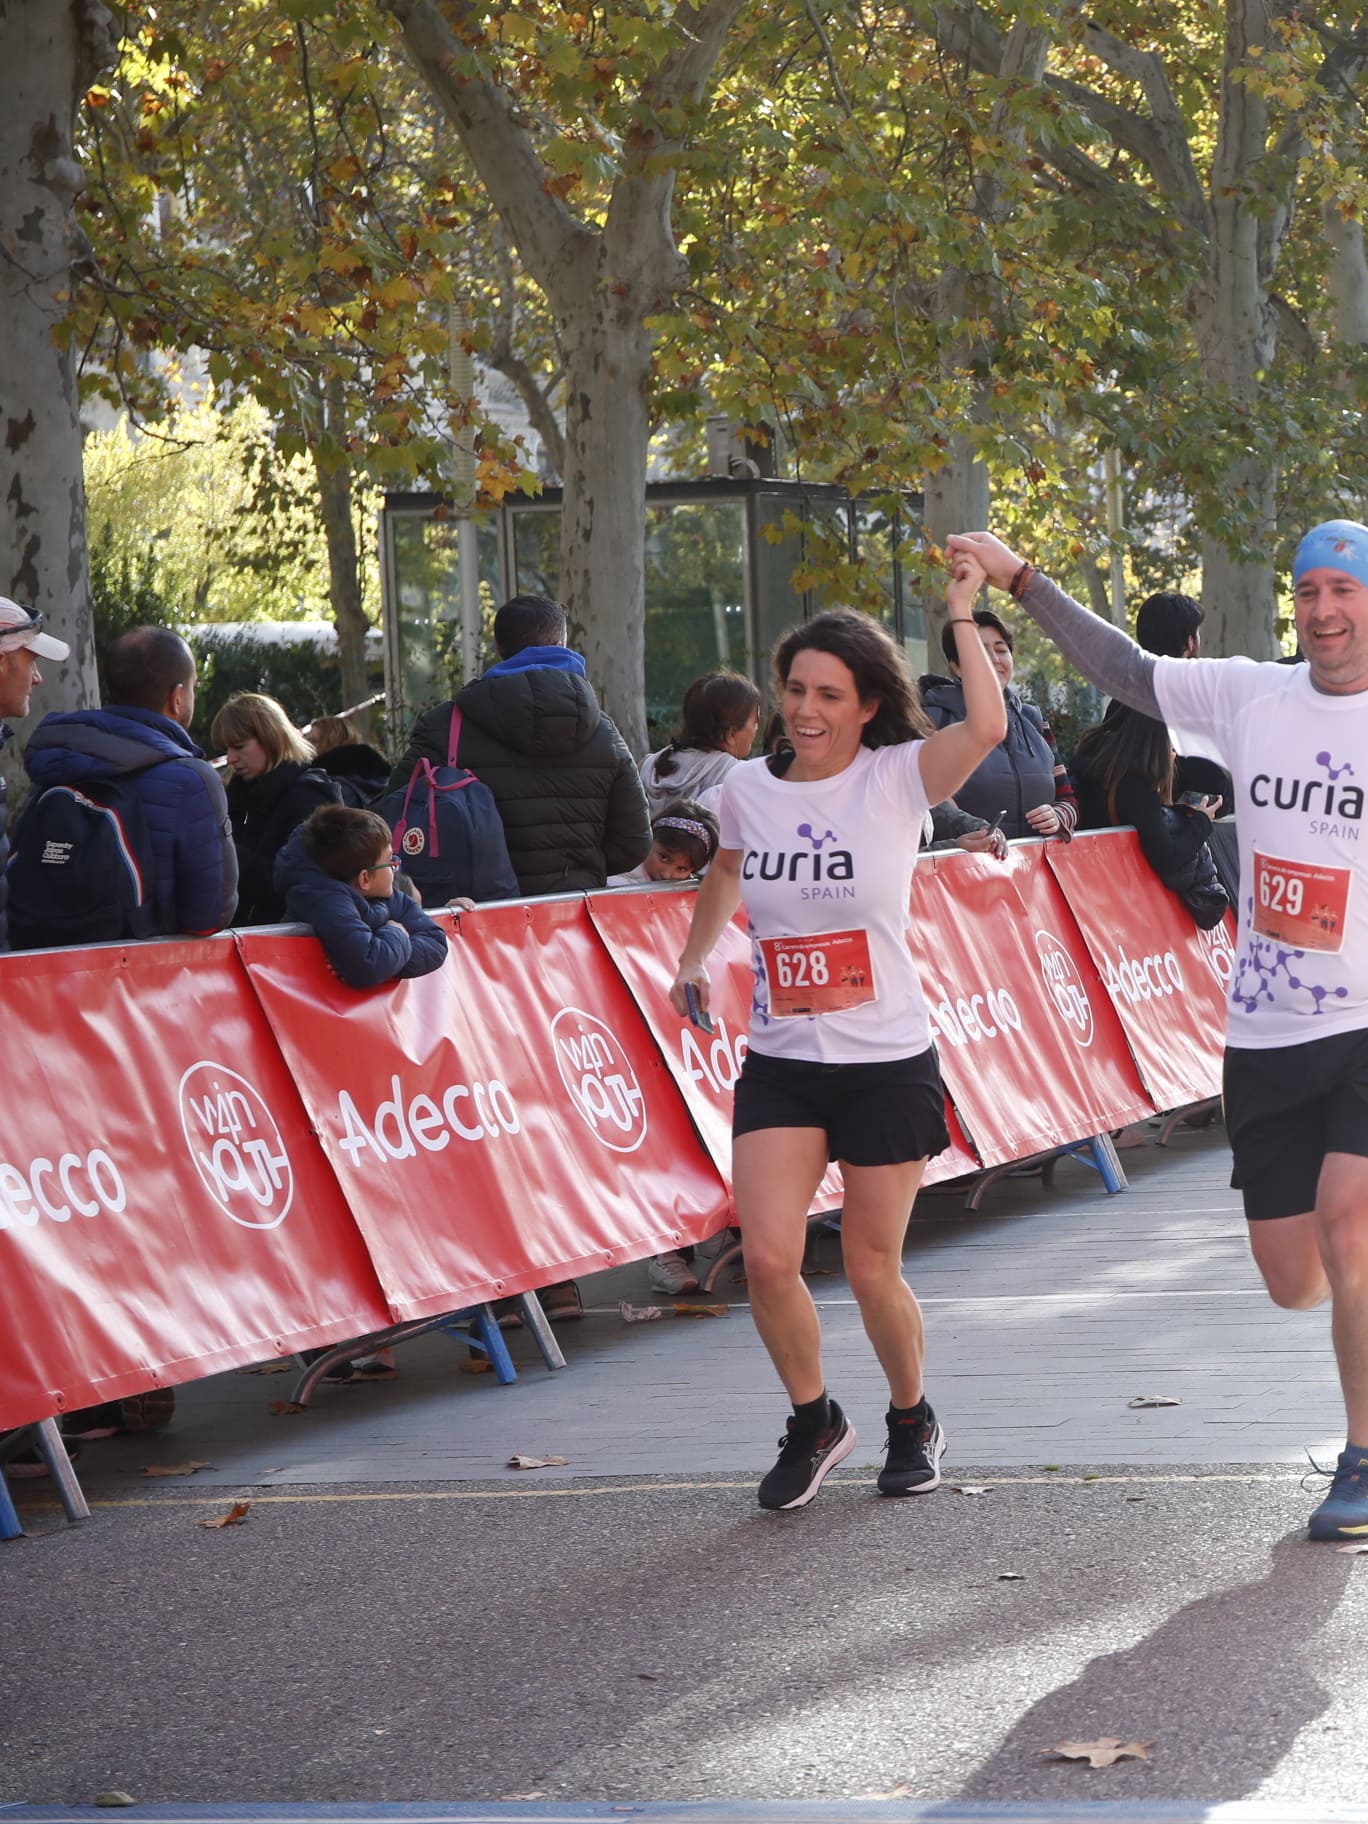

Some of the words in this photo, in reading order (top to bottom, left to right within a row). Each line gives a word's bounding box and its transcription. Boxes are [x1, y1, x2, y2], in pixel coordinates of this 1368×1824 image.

[1250, 774, 1364, 819] curia
[1309, 820, 1360, 841] SPAIN
[742, 850, 854, 881] curia
[801, 886, 855, 900] SPAIN
[1260, 870, 1304, 916] 629
[776, 950, 829, 987] 628
[1103, 945, 1184, 1004] Adecco
[338, 1074, 520, 1168] Adecco
[0, 1149, 126, 1229] ecco
